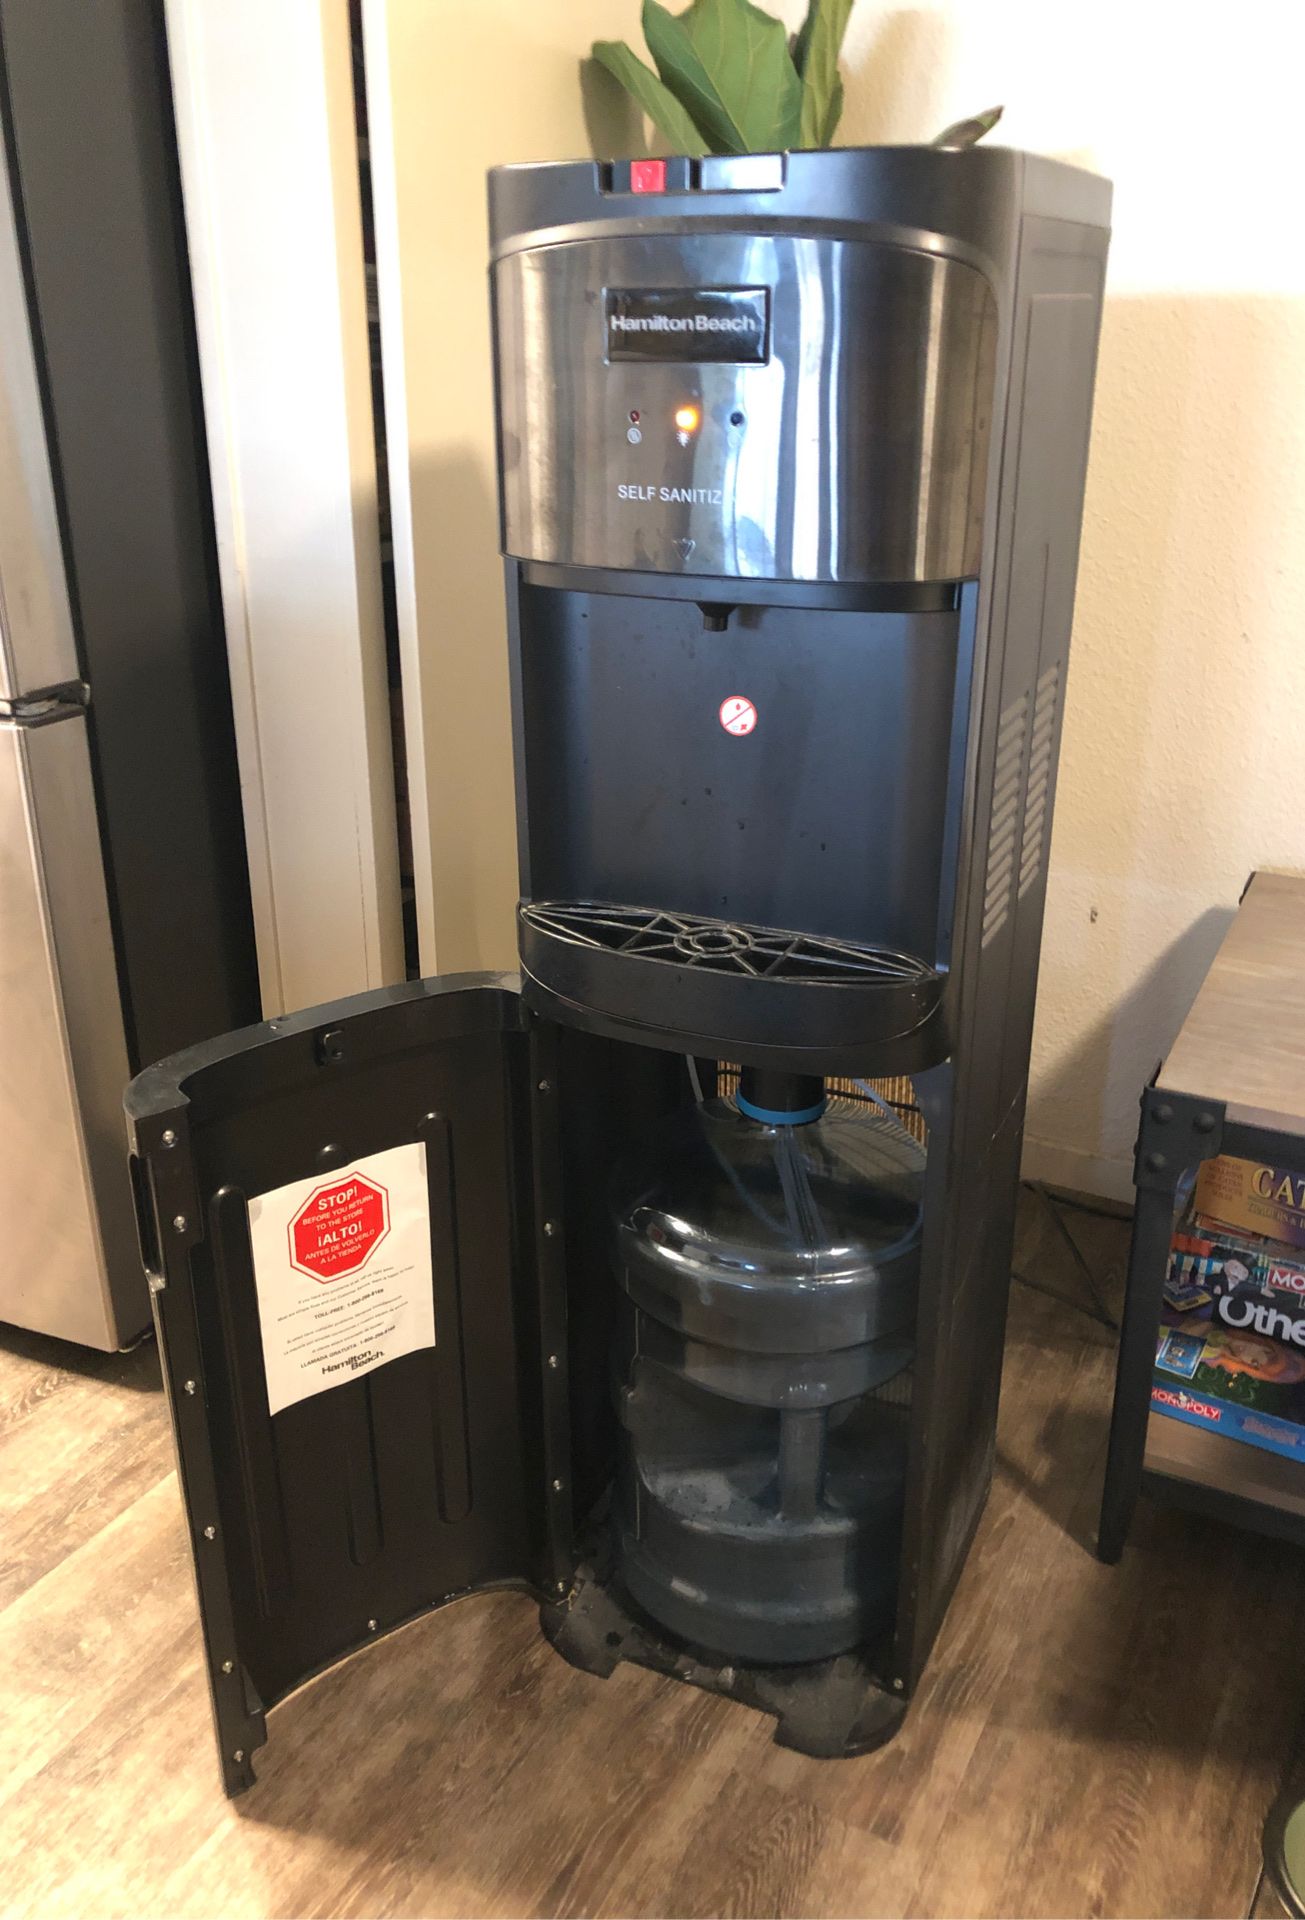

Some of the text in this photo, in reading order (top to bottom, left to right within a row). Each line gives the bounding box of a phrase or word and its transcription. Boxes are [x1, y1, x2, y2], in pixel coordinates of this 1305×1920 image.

[610, 314, 756, 332] Hamilton Beach
[617, 484, 656, 500] SELF
[302, 1194, 374, 1226] BEFORE YOU RETURN
[318, 1185, 357, 1211] STOP!
[316, 1208, 364, 1231] TO THE STORE
[304, 1228, 376, 1261] ANTES DE VOLVERLO
[327, 1254, 337, 1262] LA
[338, 1243, 362, 1258] TIENDA
[321, 1350, 372, 1375] Hamilton
